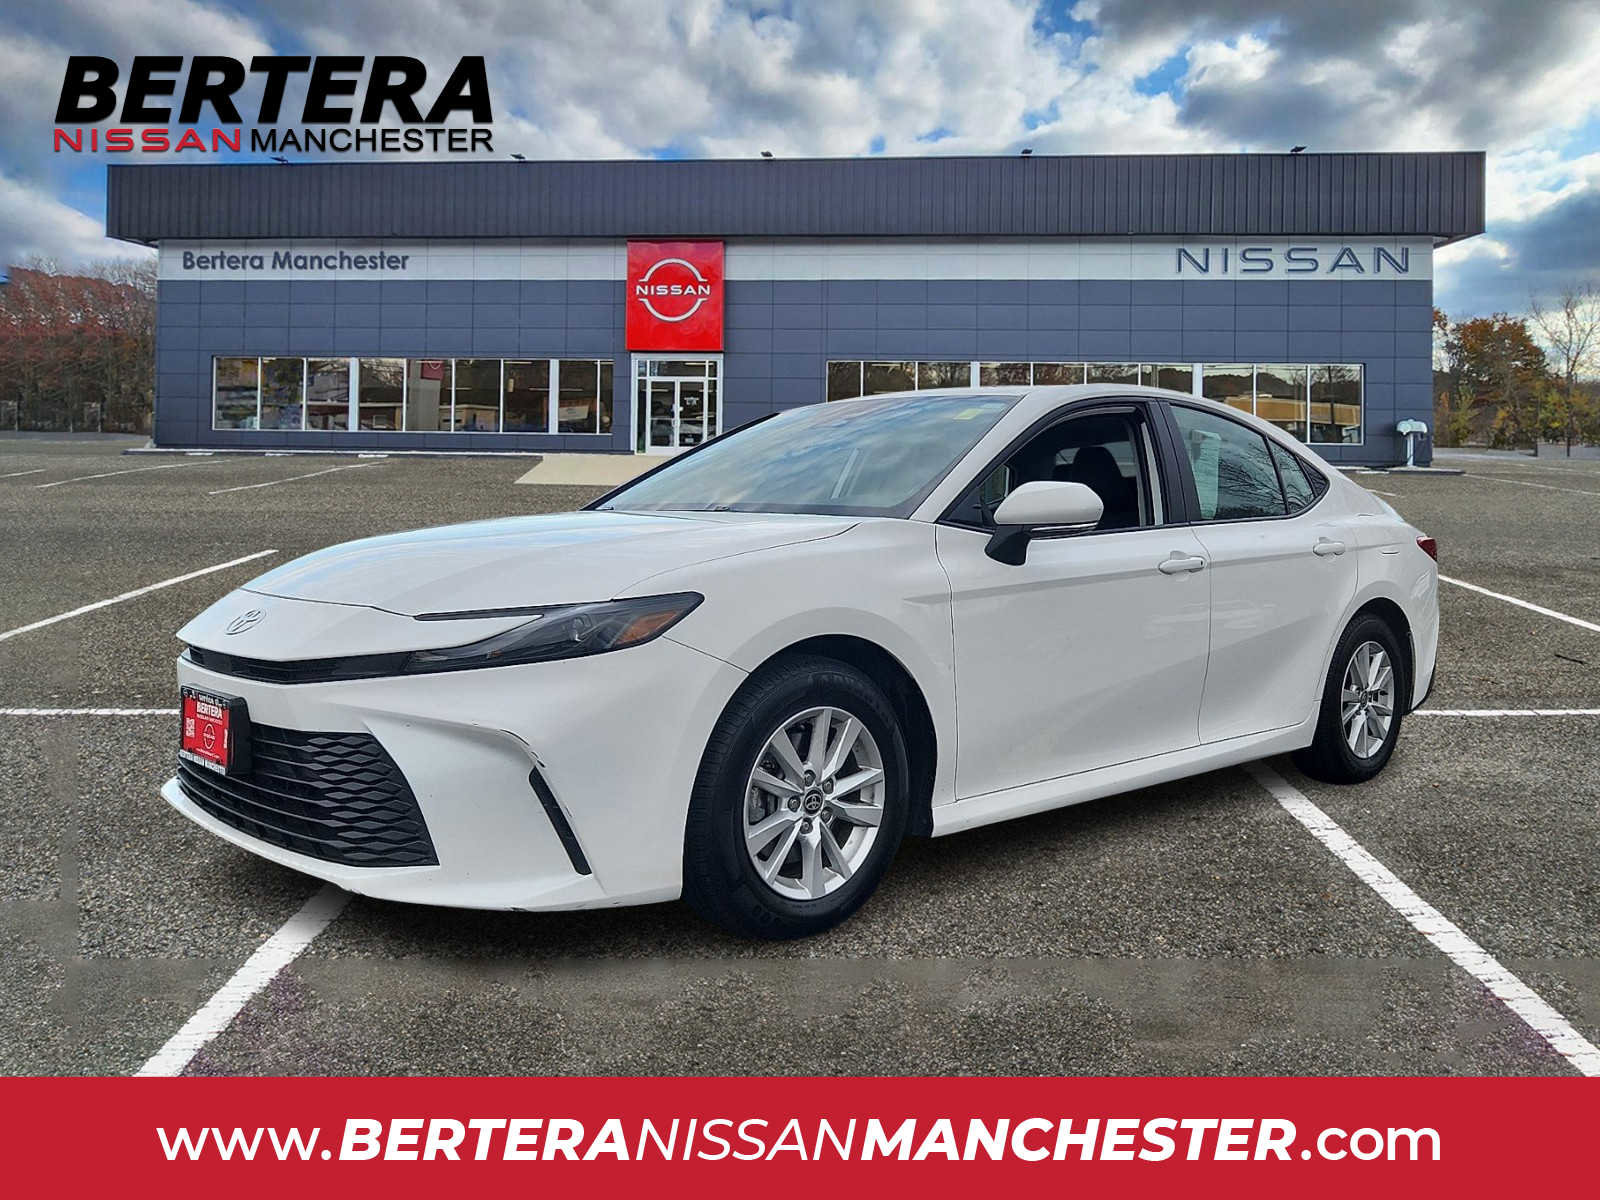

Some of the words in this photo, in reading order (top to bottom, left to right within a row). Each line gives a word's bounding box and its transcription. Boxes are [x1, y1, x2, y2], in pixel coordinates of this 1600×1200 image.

[182, 251, 264, 270] Bertera
[271, 250, 409, 270] Manchester
[1176, 247, 1410, 274] NISSAN
[636, 284, 711, 296] NISSAN
